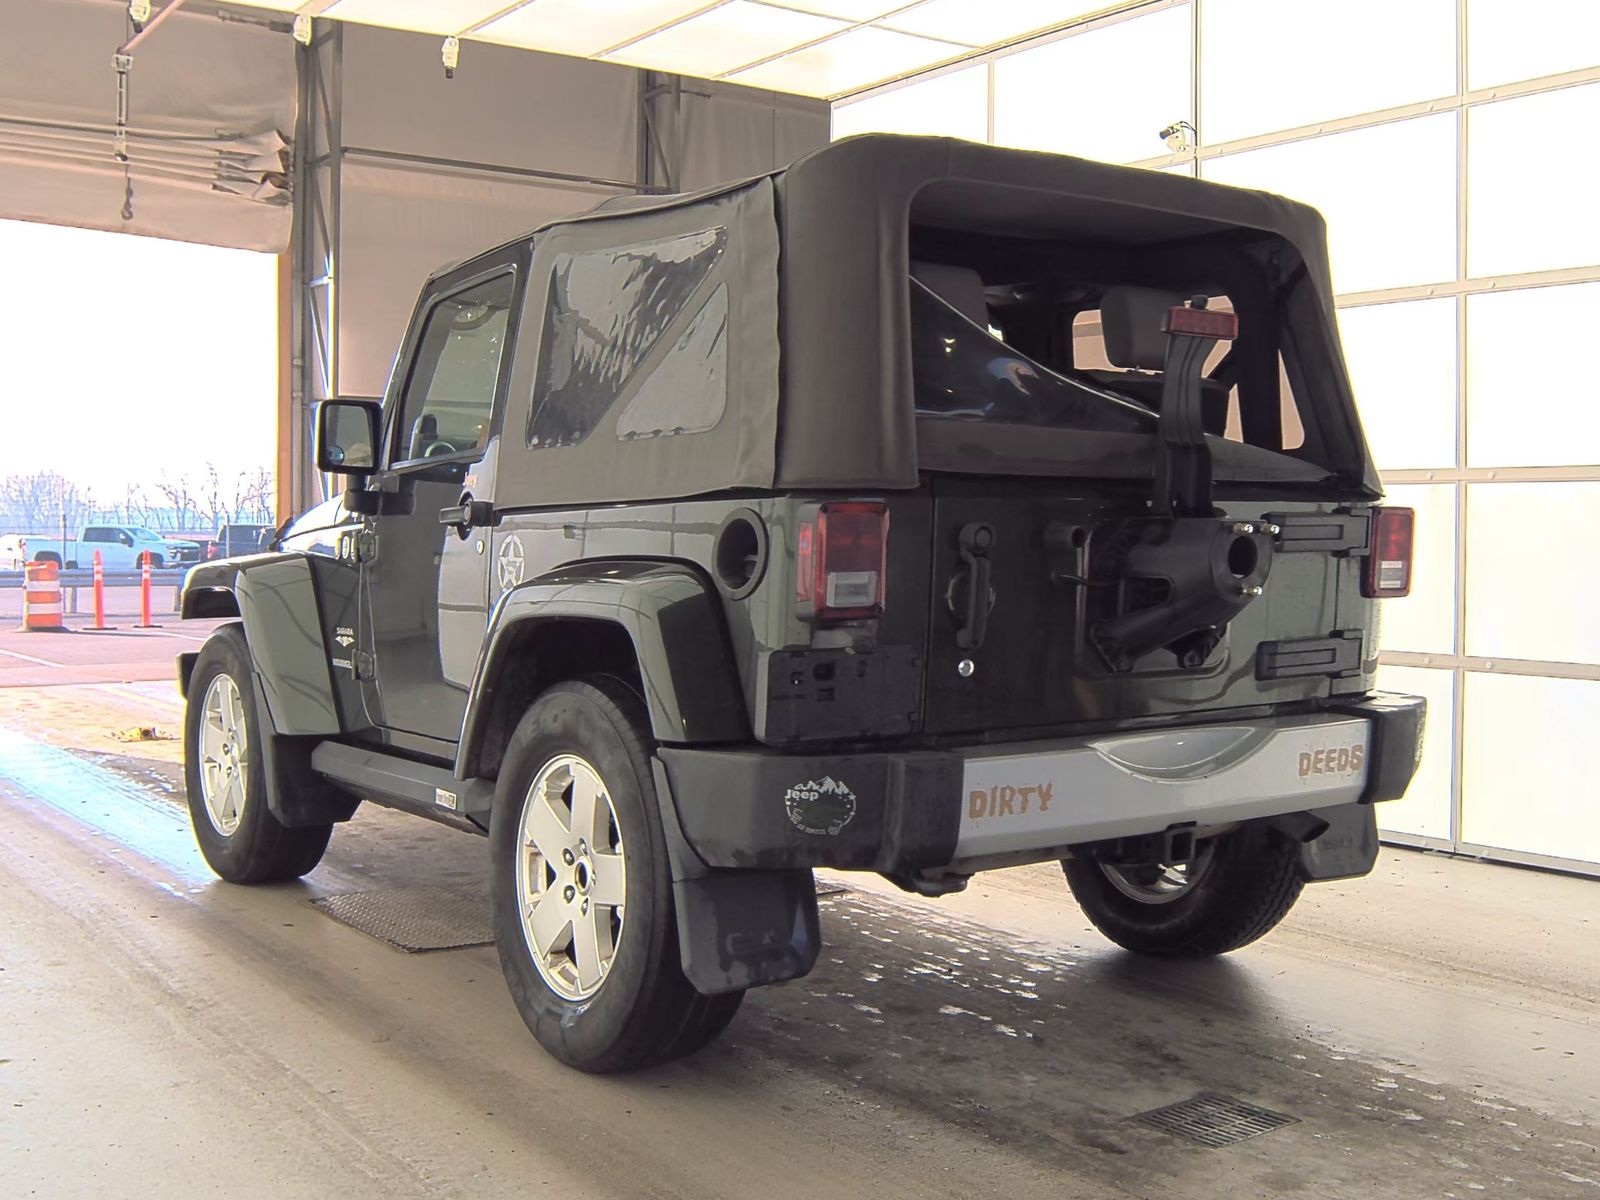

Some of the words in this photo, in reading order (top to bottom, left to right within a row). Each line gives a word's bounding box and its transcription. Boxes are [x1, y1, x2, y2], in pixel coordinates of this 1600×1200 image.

[784, 789, 819, 801] Jeep
[968, 781, 1052, 818] DIRTY
[1298, 744, 1363, 776] DEEDS
